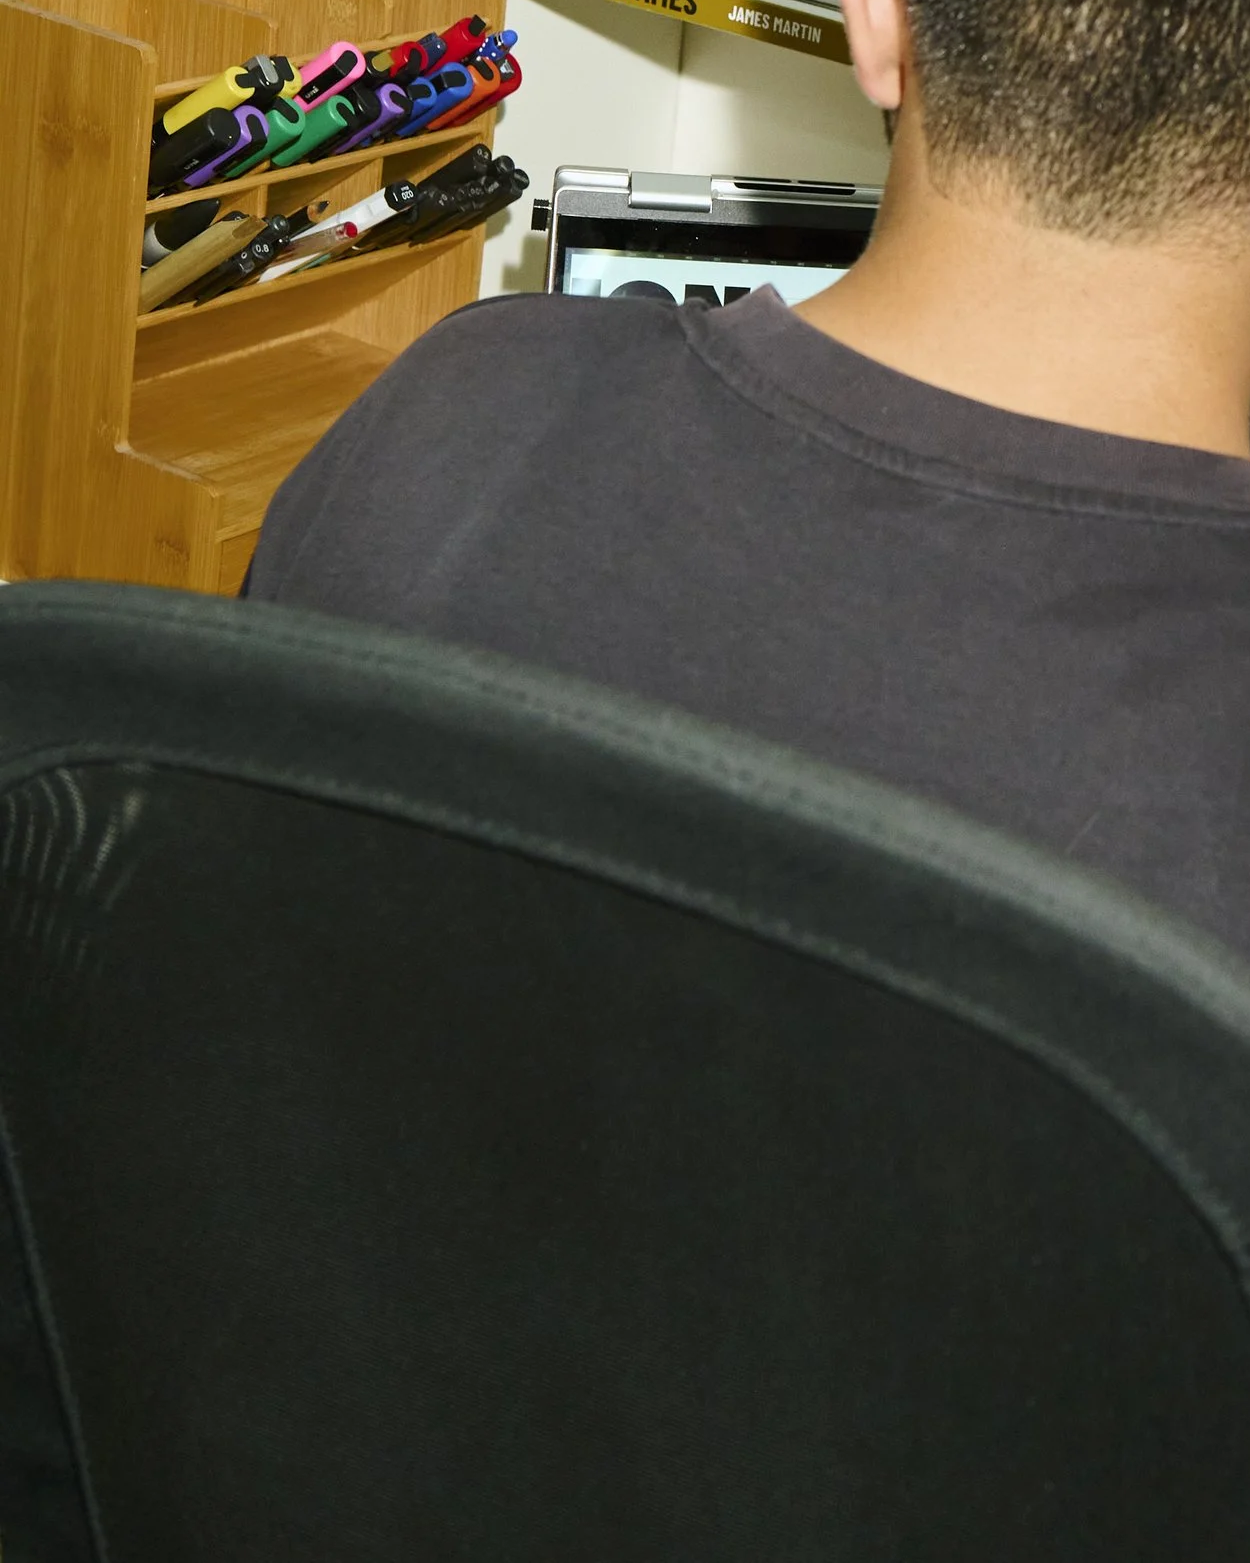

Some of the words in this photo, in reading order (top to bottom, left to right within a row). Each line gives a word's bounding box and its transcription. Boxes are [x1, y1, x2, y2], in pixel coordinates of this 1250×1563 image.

[727, 5, 770, 29] JAMES
[773, 16, 821, 43] MARTIN
[255, 243, 269, 254] 0.8
